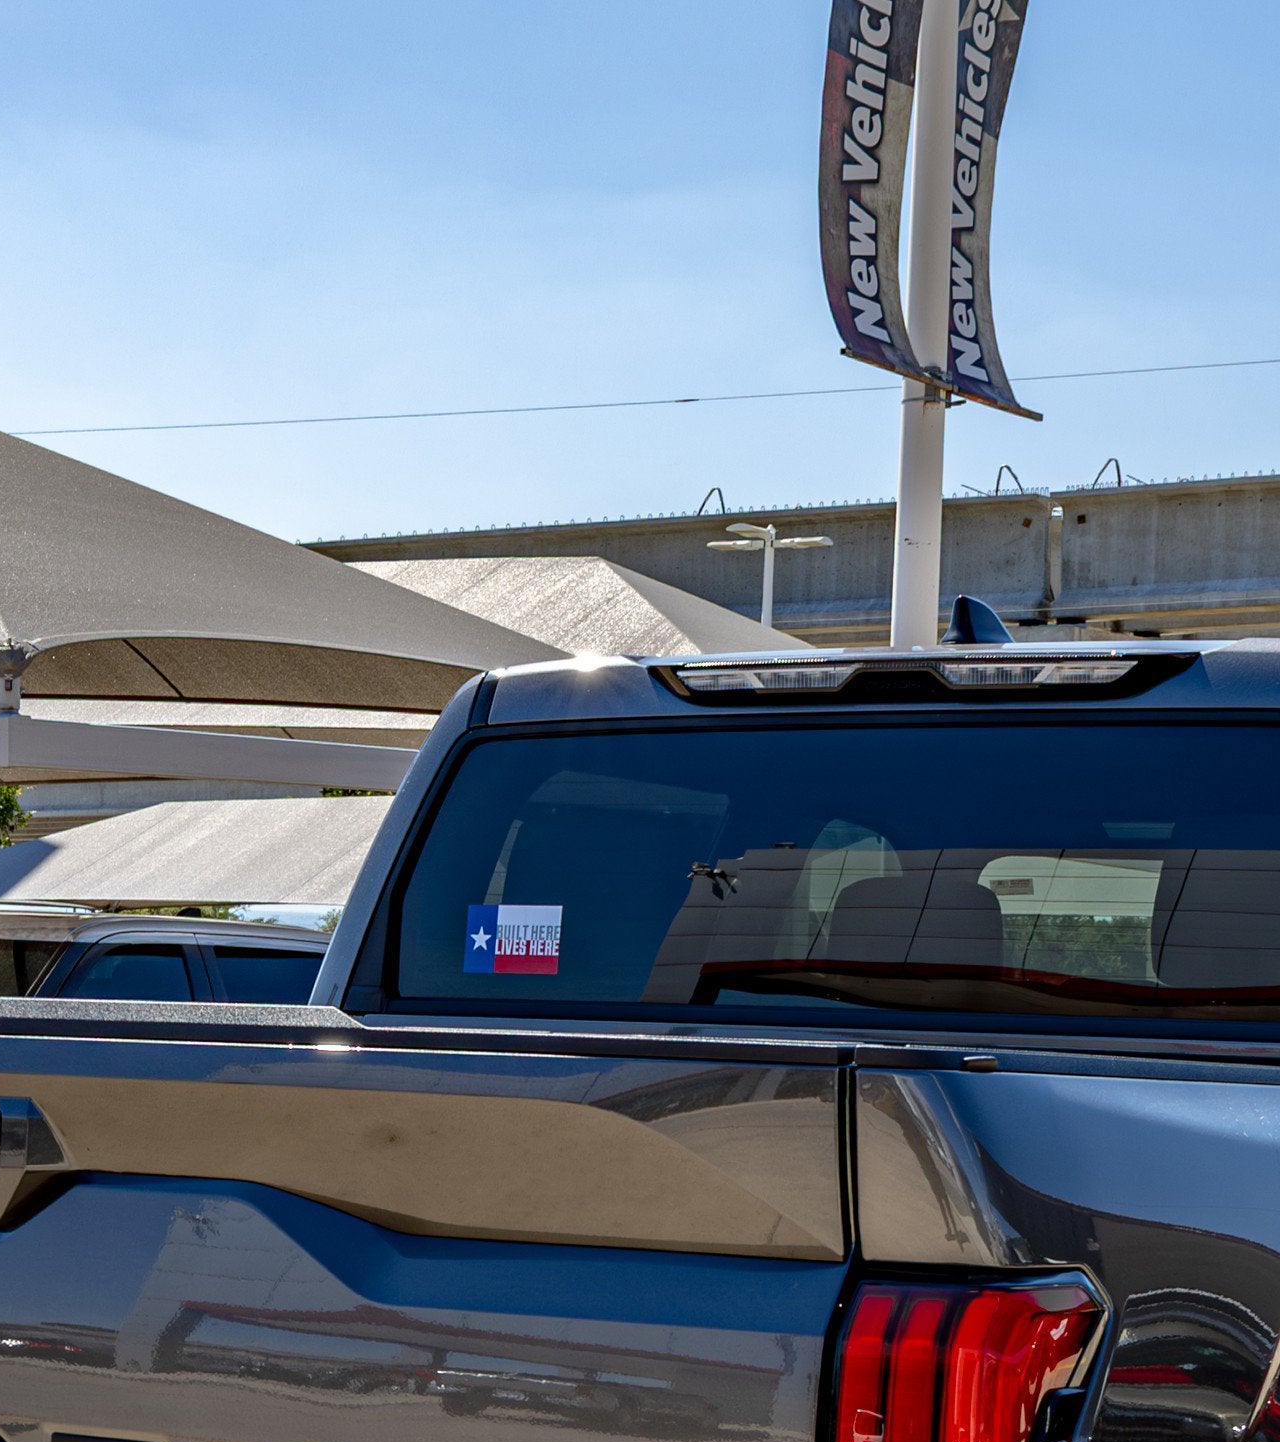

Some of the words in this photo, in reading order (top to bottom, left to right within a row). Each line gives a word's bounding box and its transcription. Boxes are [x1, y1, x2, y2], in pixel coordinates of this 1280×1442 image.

[846, 201, 891, 343] New
[950, 246, 990, 383] New
[494, 939, 527, 956] LIVES
[529, 940, 560, 957] HERE
[497, 924, 529, 940] BUILT
[531, 925, 560, 941] HERE
